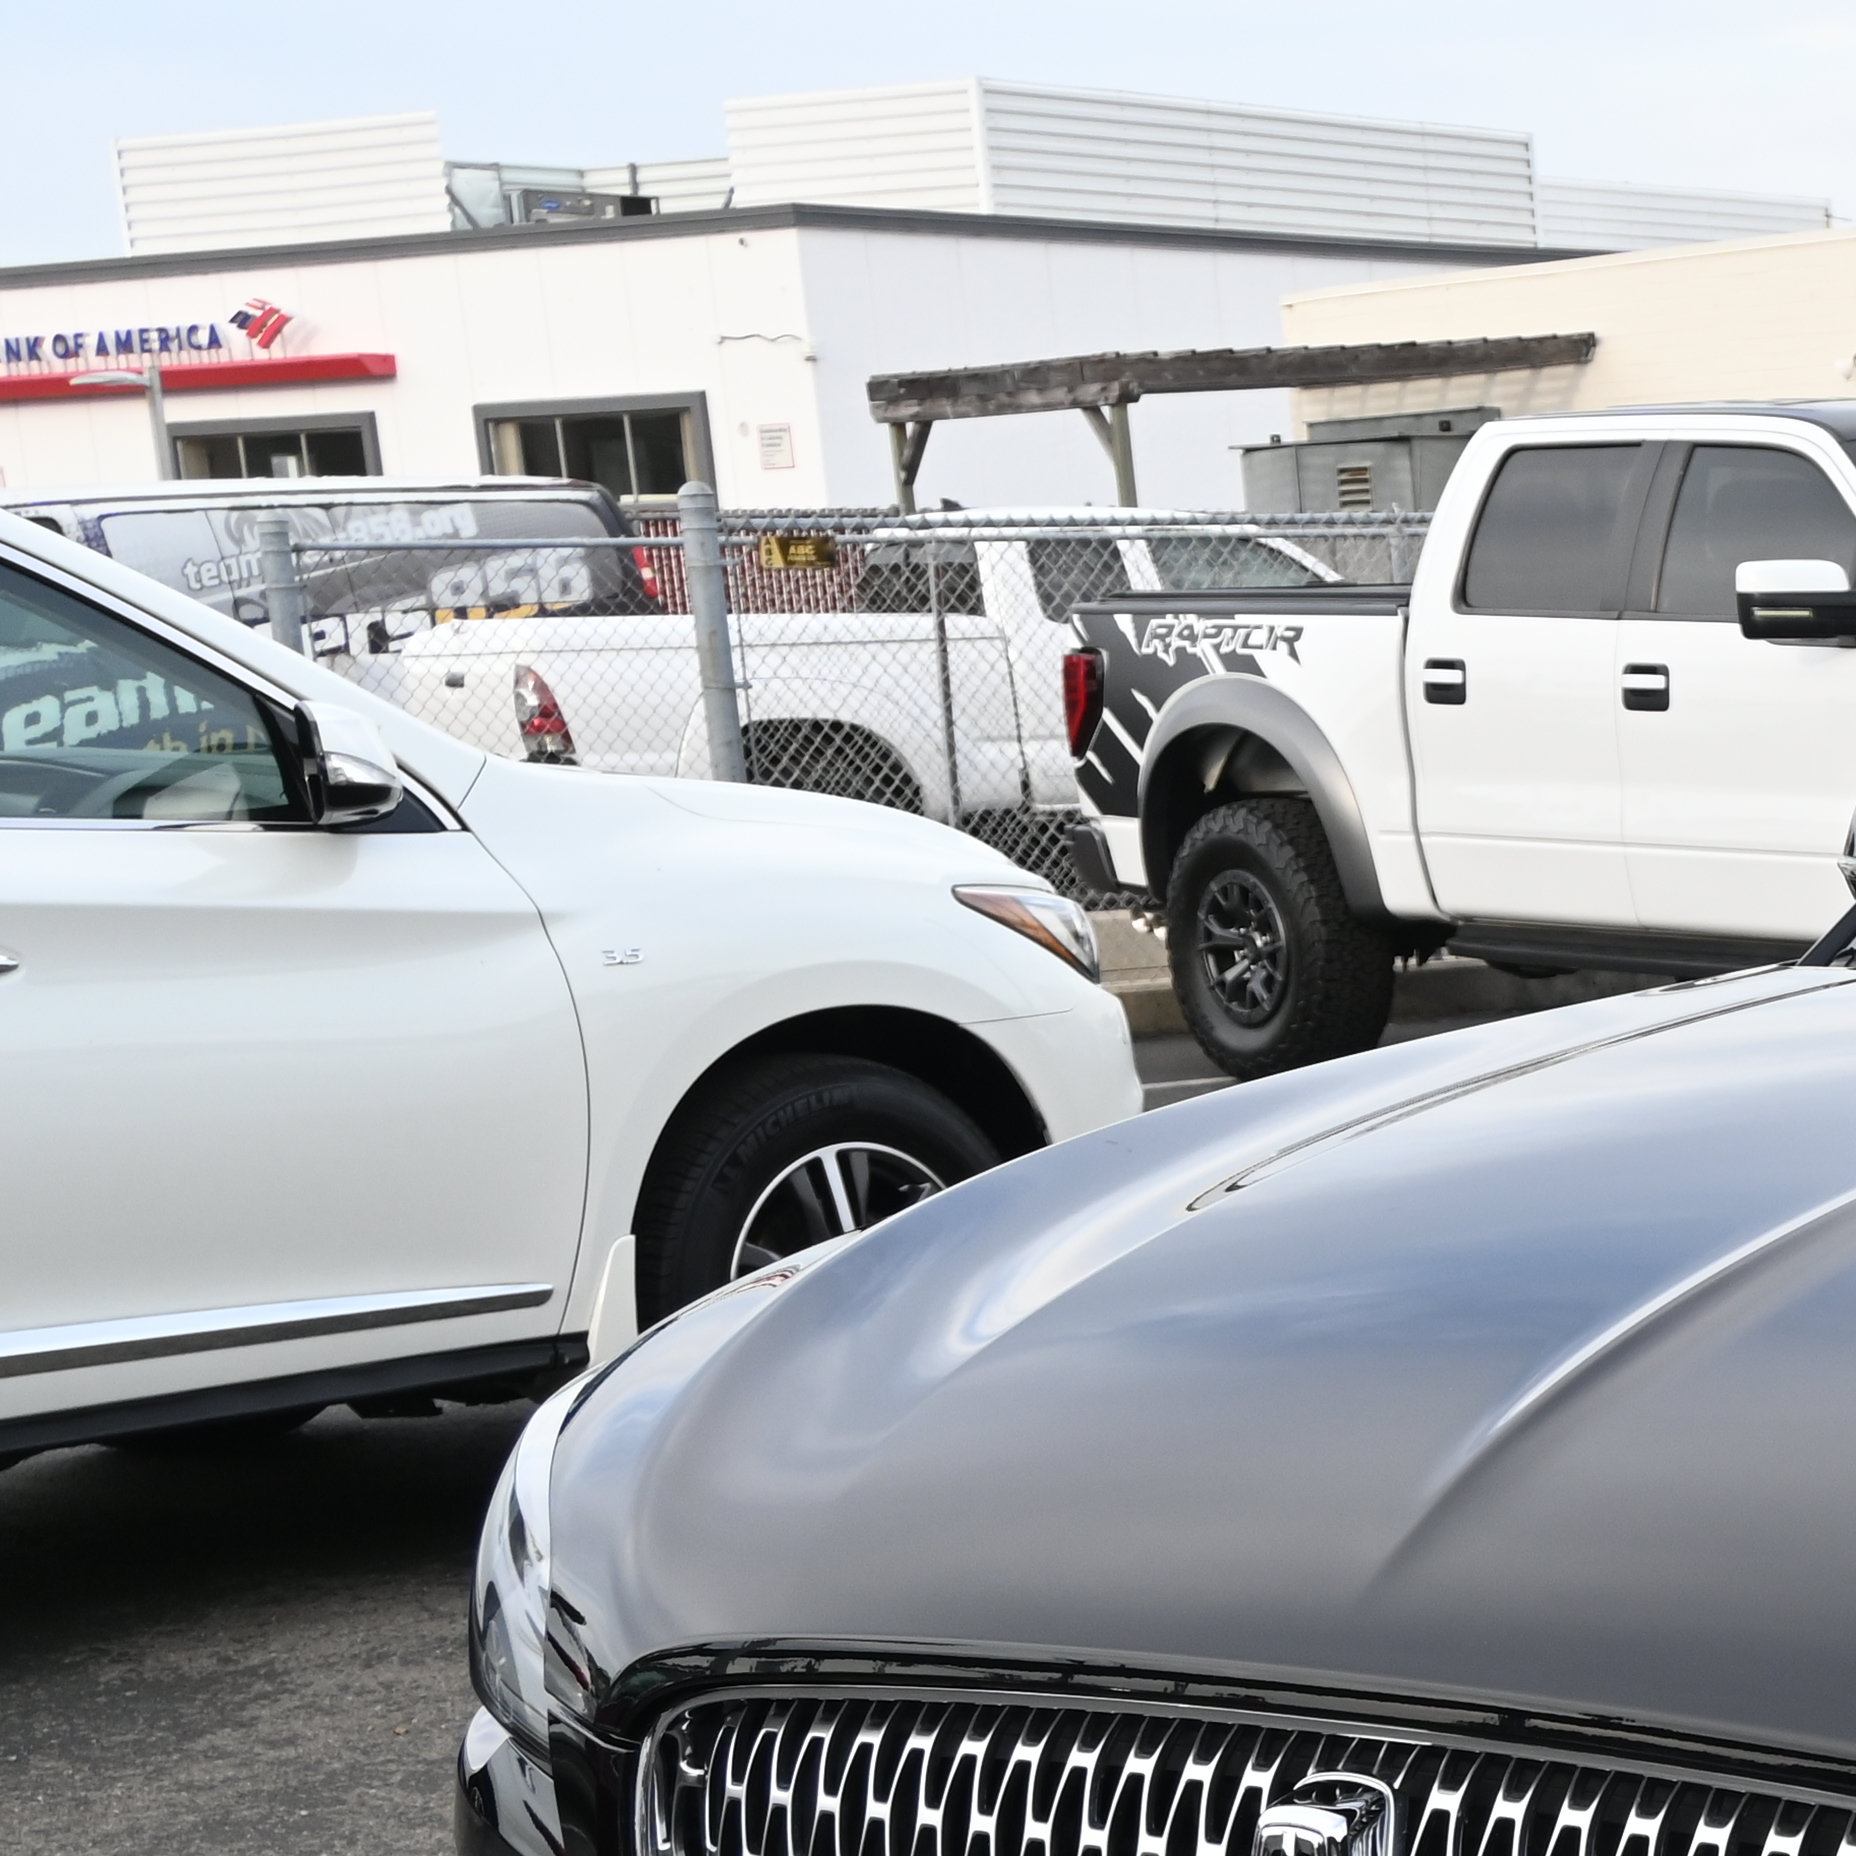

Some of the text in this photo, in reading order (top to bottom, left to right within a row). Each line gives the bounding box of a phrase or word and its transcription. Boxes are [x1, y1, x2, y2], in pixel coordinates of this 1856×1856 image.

[0, 323, 223, 363] NK OF AMERICA
[181, 502, 477, 590] team-856.org
[430, 548, 592, 608] 856
[1141, 618, 1303, 666] RAPTOR
[601, 948, 643, 967] 3.5
